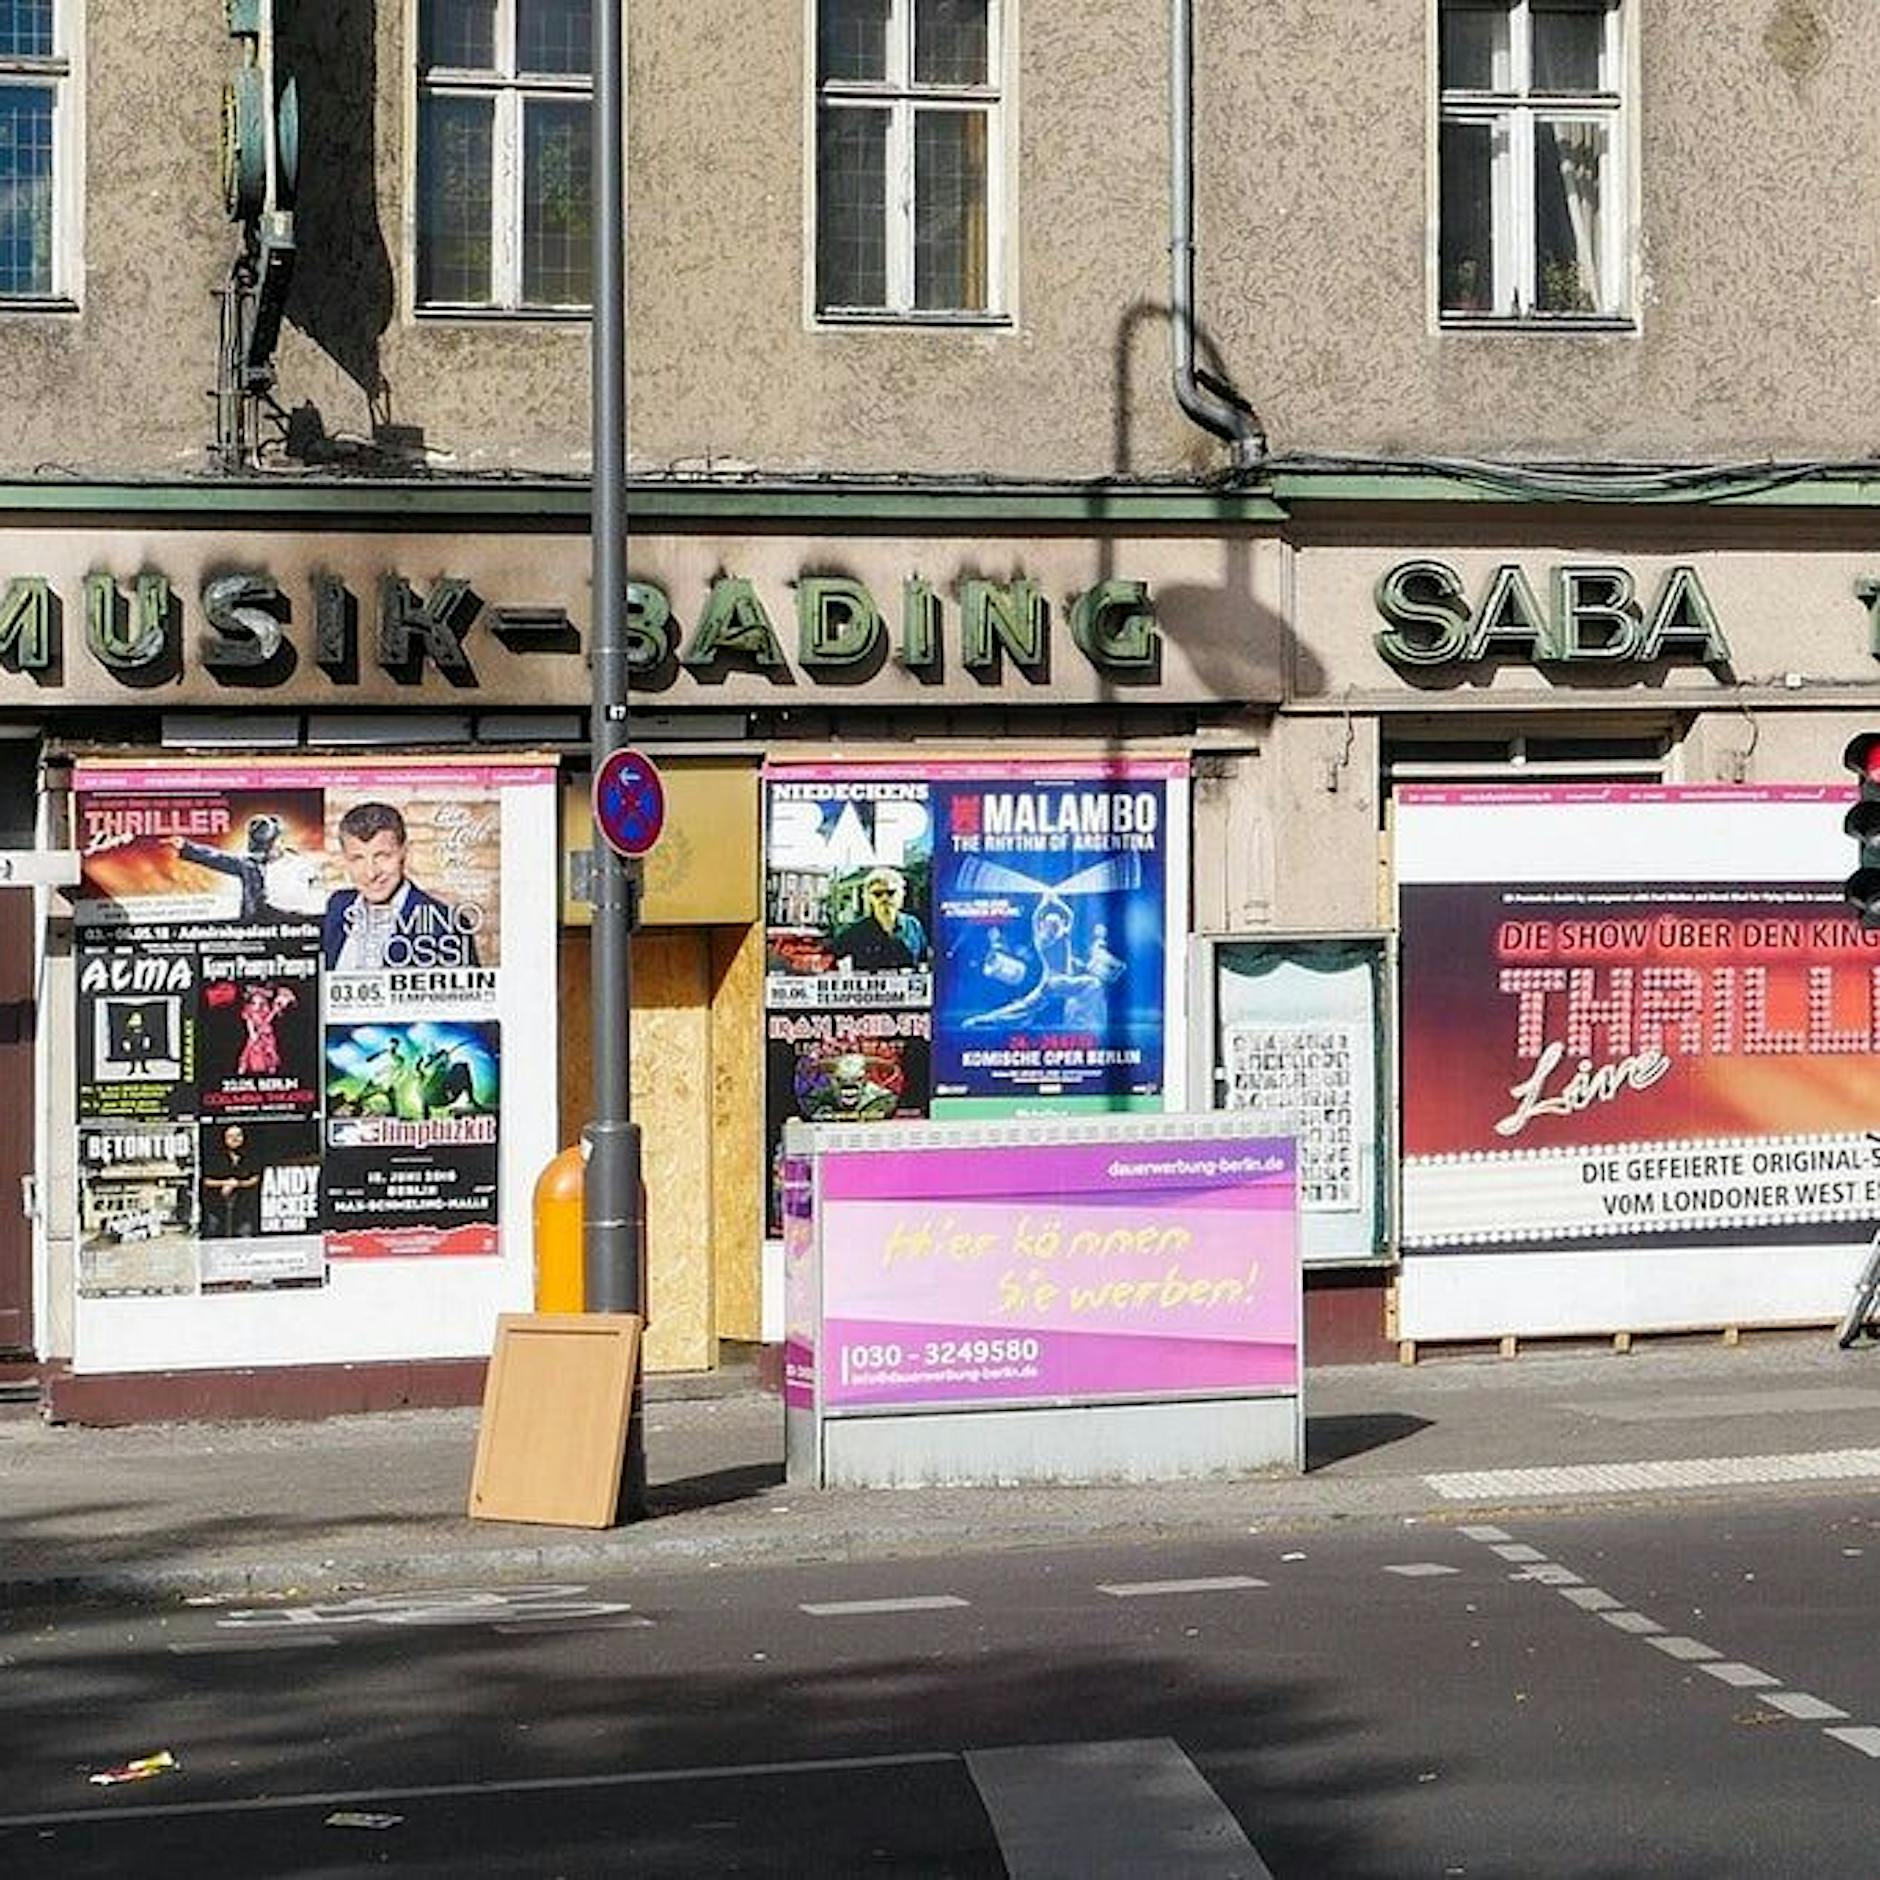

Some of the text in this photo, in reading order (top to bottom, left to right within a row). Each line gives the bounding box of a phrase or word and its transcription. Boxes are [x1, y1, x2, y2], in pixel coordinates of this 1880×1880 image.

[1374, 560, 1733, 668] SABA
[773, 784, 929, 799] NIEDECKENS
[84, 809, 231, 836] THRILLER
[984, 794, 1157, 833] MALAMBO
[768, 800, 930, 870] BAP
[952, 834, 980, 852] THE
[1503, 914, 1880, 950] DIE SHOW ÜBER DEN KING
[390, 971, 496, 991] BERLIN
[1499, 966, 1880, 1058] THRILL
[1493, 1041, 1671, 1137] Live
[1108, 1156, 1284, 1177] dauerwerbung-berlin.de
[1582, 1161, 1620, 1184] DIE
[1626, 1154, 1743, 1182] GEFEIERTE
[1602, 1180, 1880, 1216] VOM LONDONER WEST E
[851, 1346, 901, 1368] 030
[925, 1339, 1039, 1365] 3249580
